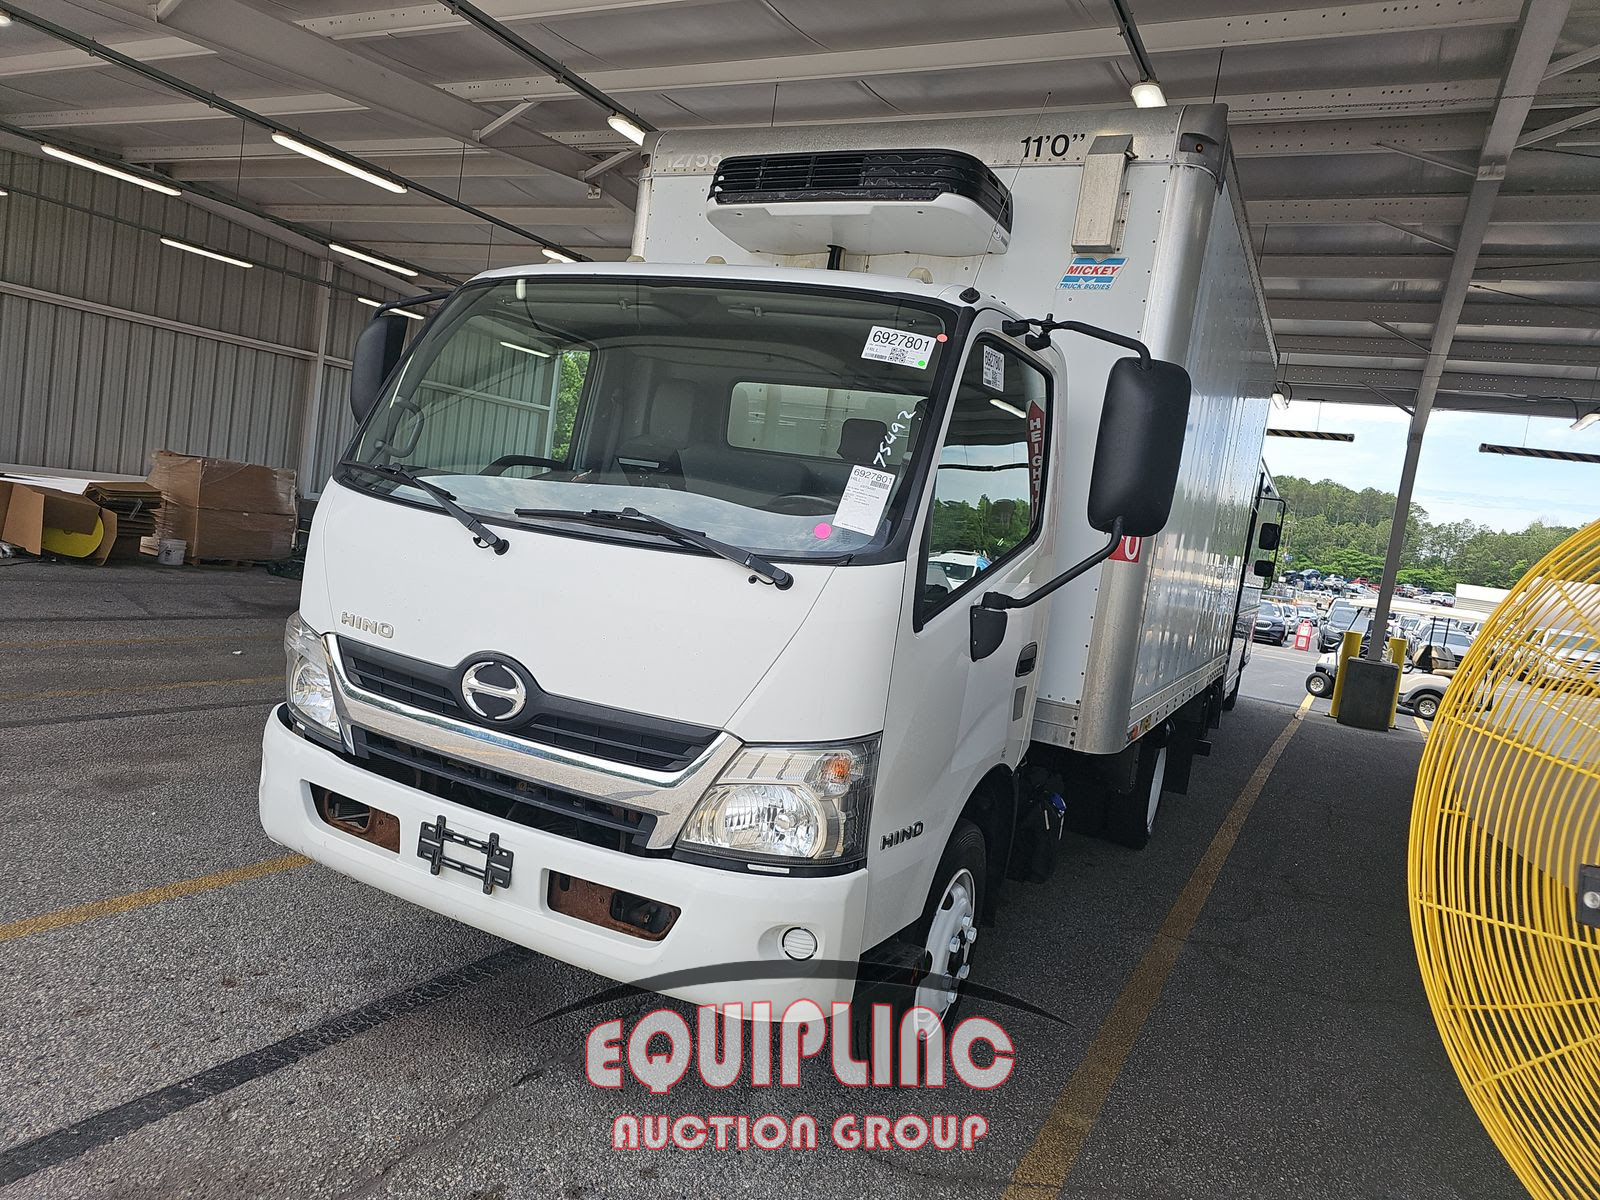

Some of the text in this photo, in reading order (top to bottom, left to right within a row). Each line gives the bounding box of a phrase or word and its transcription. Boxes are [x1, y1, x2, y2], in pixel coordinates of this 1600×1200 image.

[1066, 265, 1120, 275] MICKEY
[872, 330, 930, 352] 6927801
[853, 468, 893, 484] 6927801
[341, 611, 395, 639] HINO
[880, 820, 924, 851] HINO
